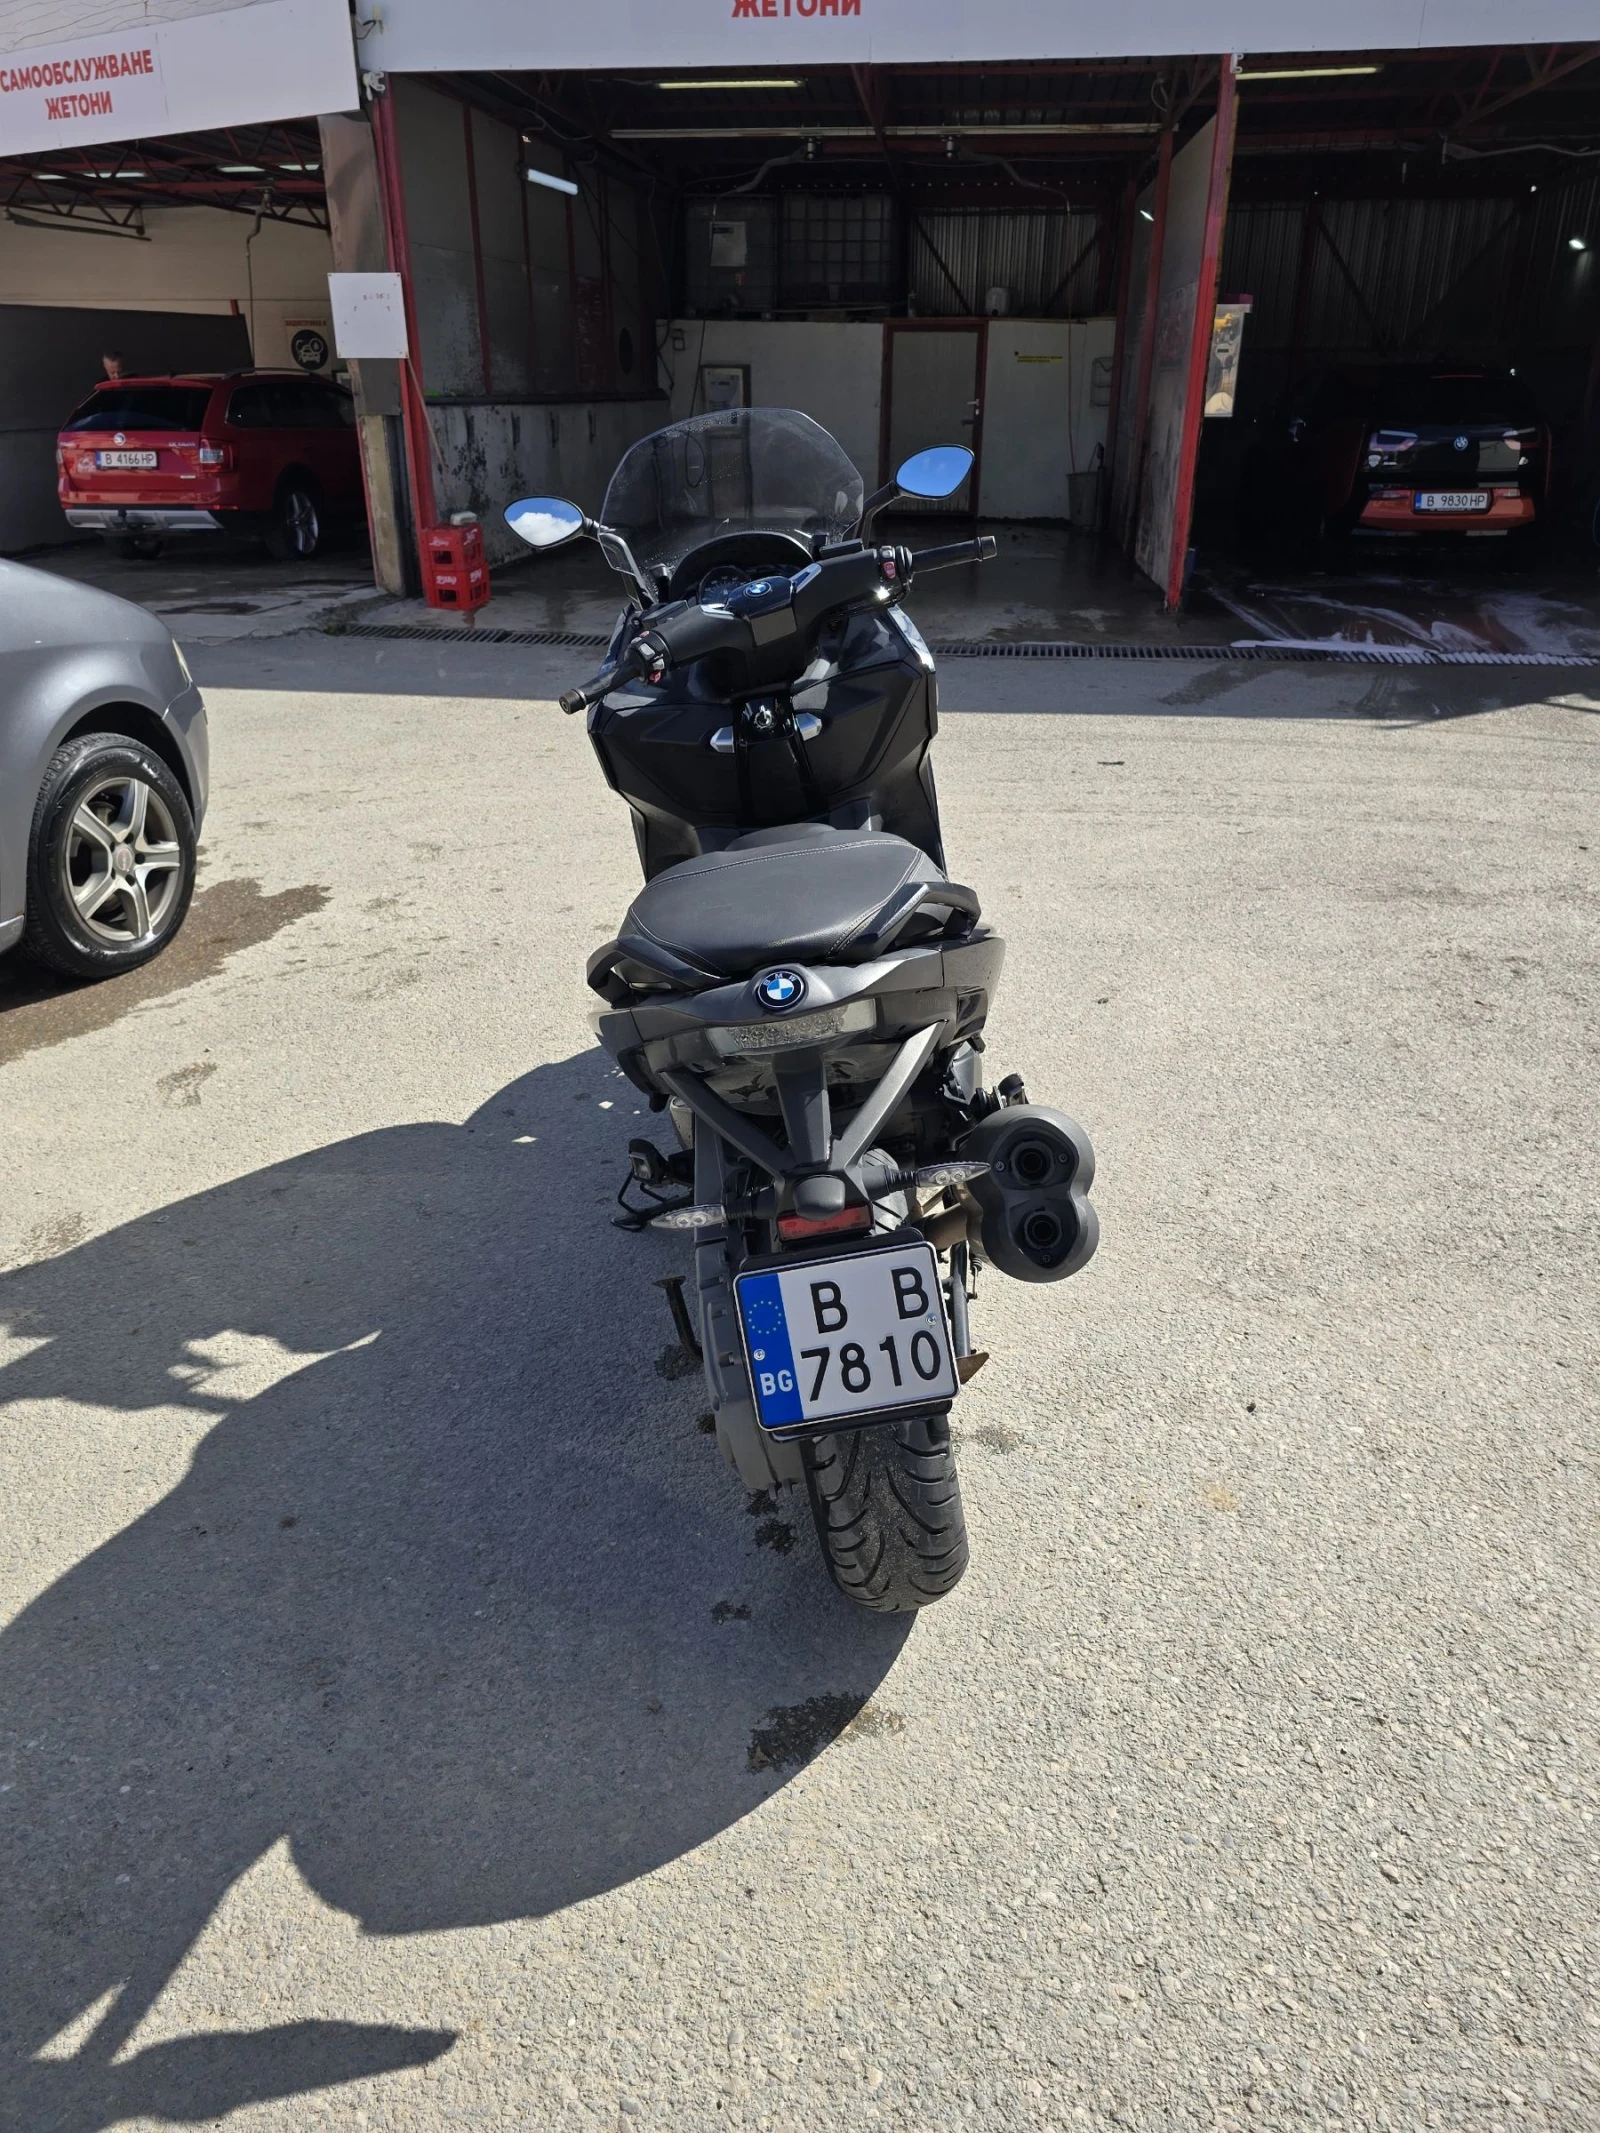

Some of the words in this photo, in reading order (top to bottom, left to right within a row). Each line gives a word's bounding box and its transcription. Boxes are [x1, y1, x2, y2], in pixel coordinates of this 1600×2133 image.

[731, 0, 861, 17] ЖЕТОНИ
[0, 49, 154, 92] САМООБСЛУЖВАНЕ
[45, 91, 113, 120] ЖЕТОНИ
[763, 972, 798, 986] BMW
[810, 1280, 848, 1335] B
[891, 1266, 929, 1320] B
[800, 1330, 941, 1402] 7810
[759, 1369, 794, 1396] BG
